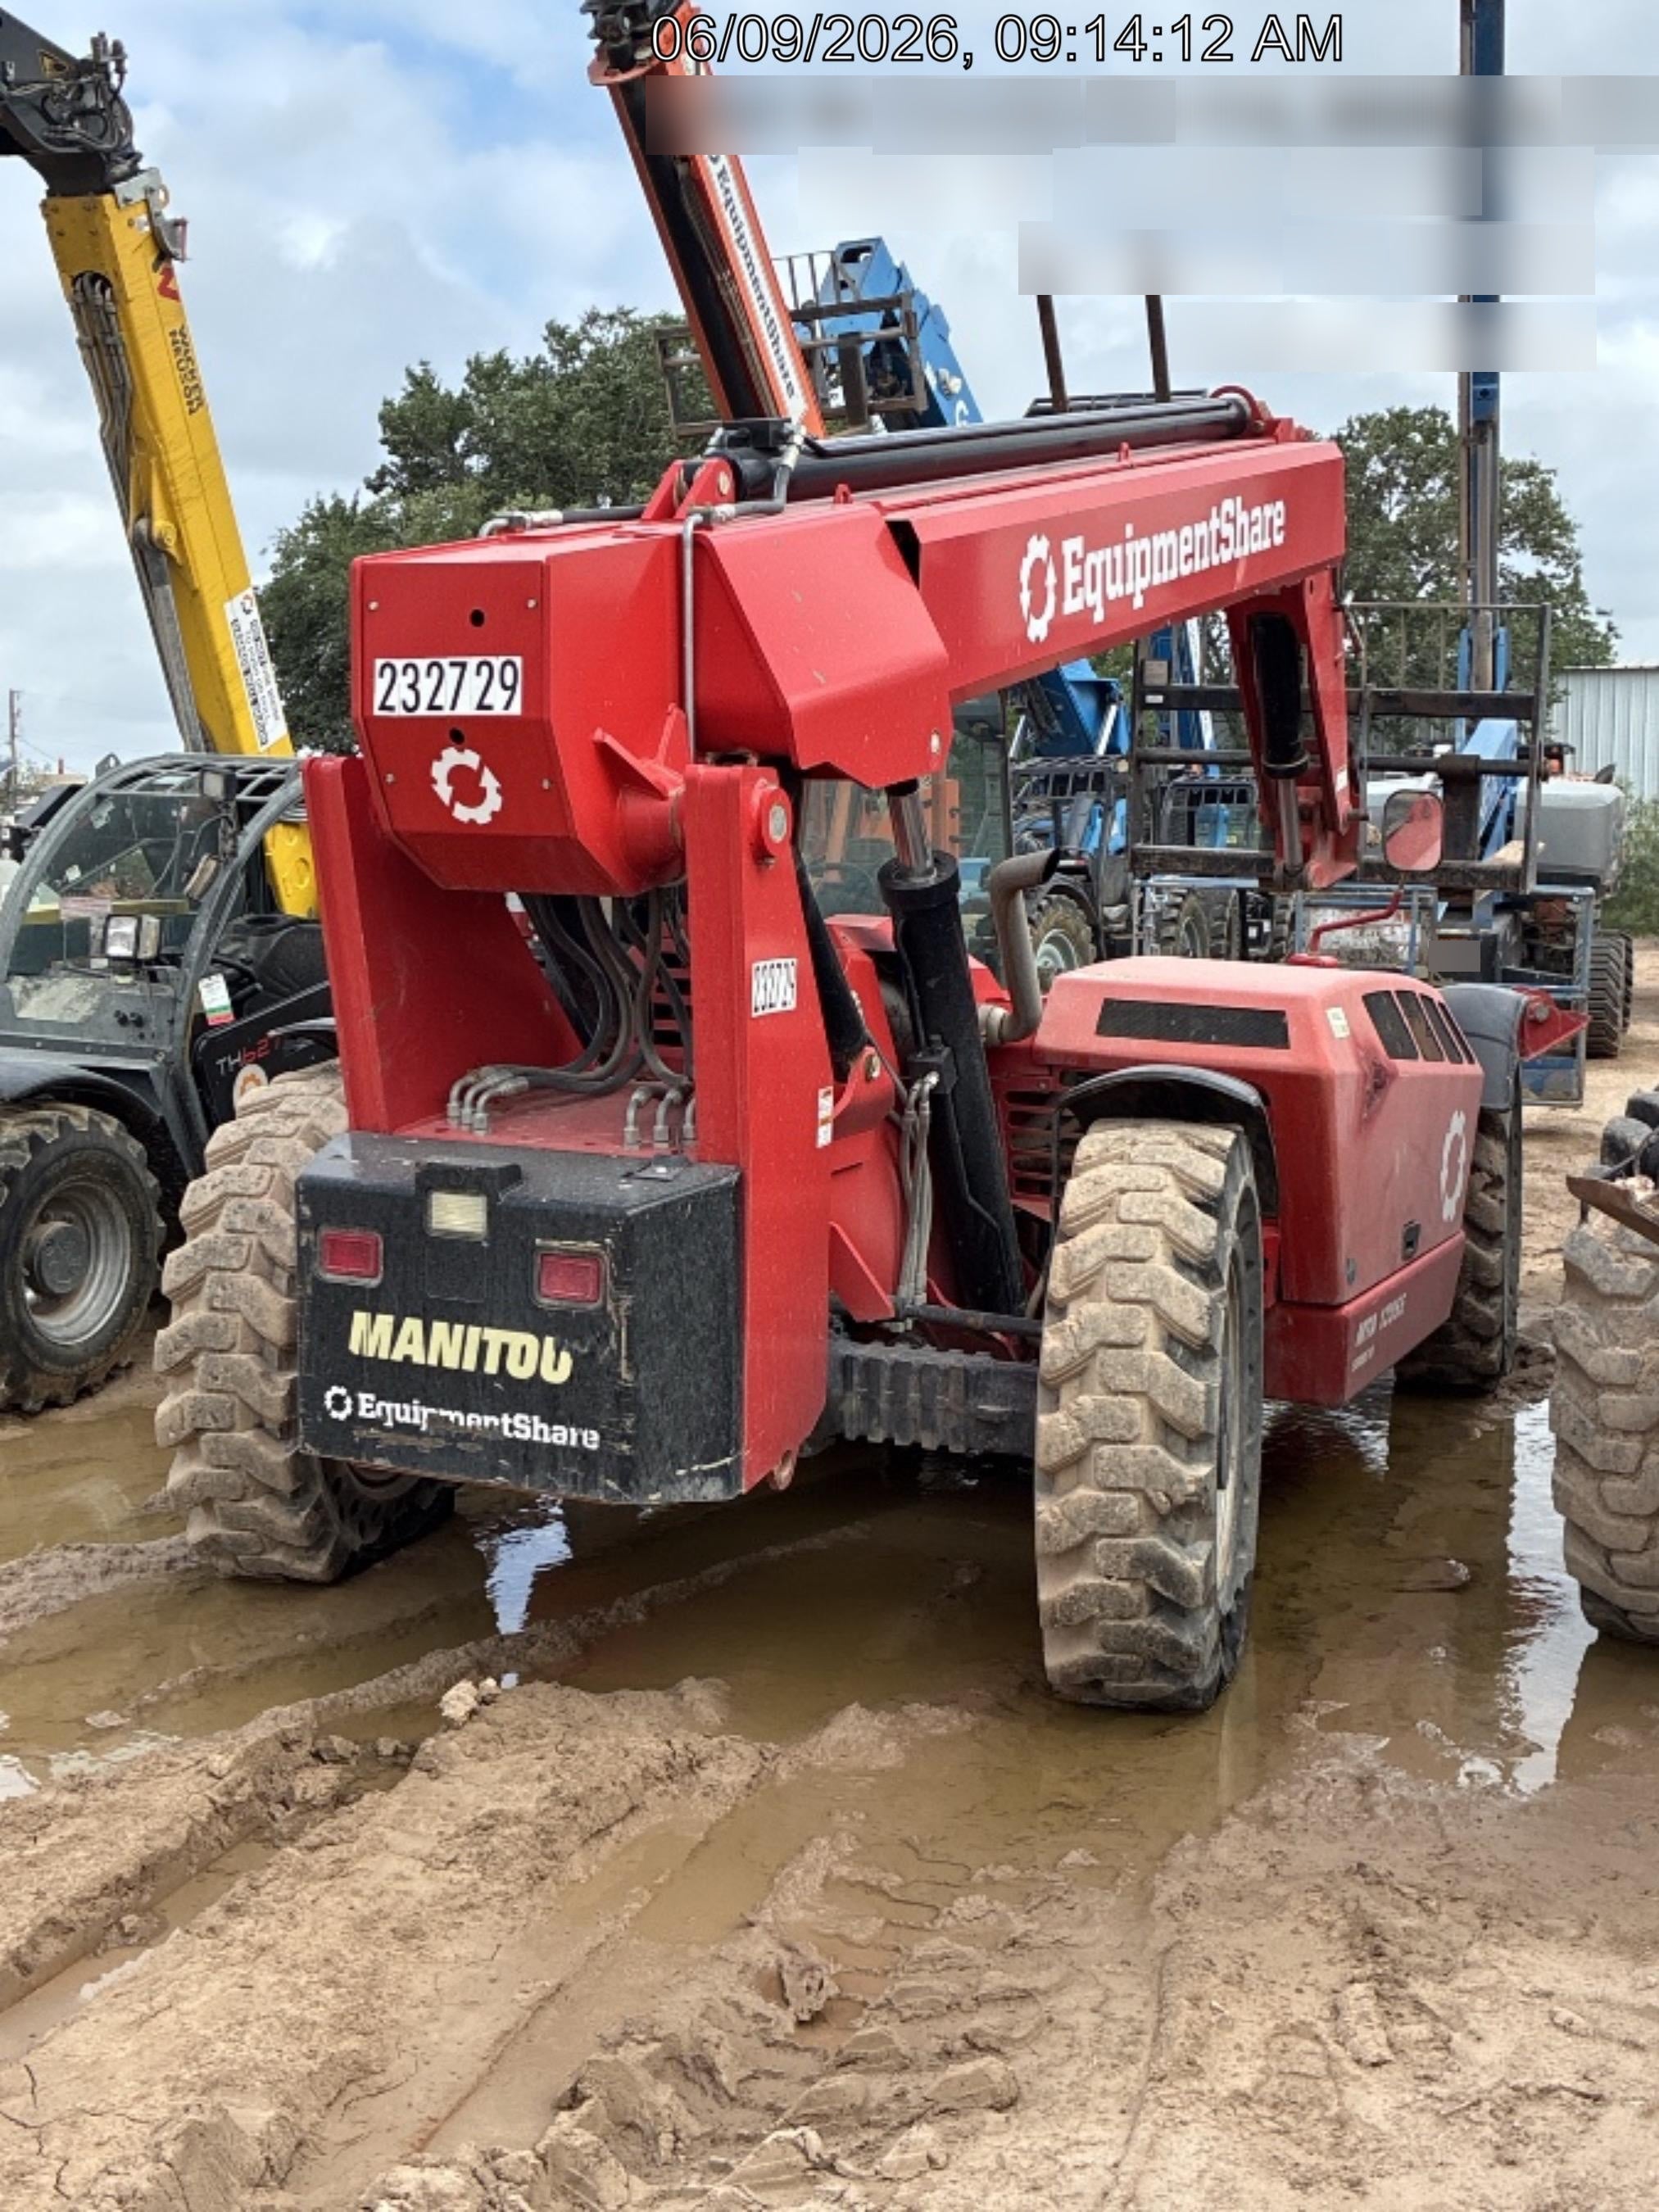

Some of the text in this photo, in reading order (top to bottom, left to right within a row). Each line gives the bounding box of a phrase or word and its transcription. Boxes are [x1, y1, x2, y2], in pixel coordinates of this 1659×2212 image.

[716, 164, 796, 400] EquipmentShare
[1062, 496, 1285, 623] EquipmentShare
[378, 660, 519, 713] 232729
[348, 1310, 573, 1385] MANITOU
